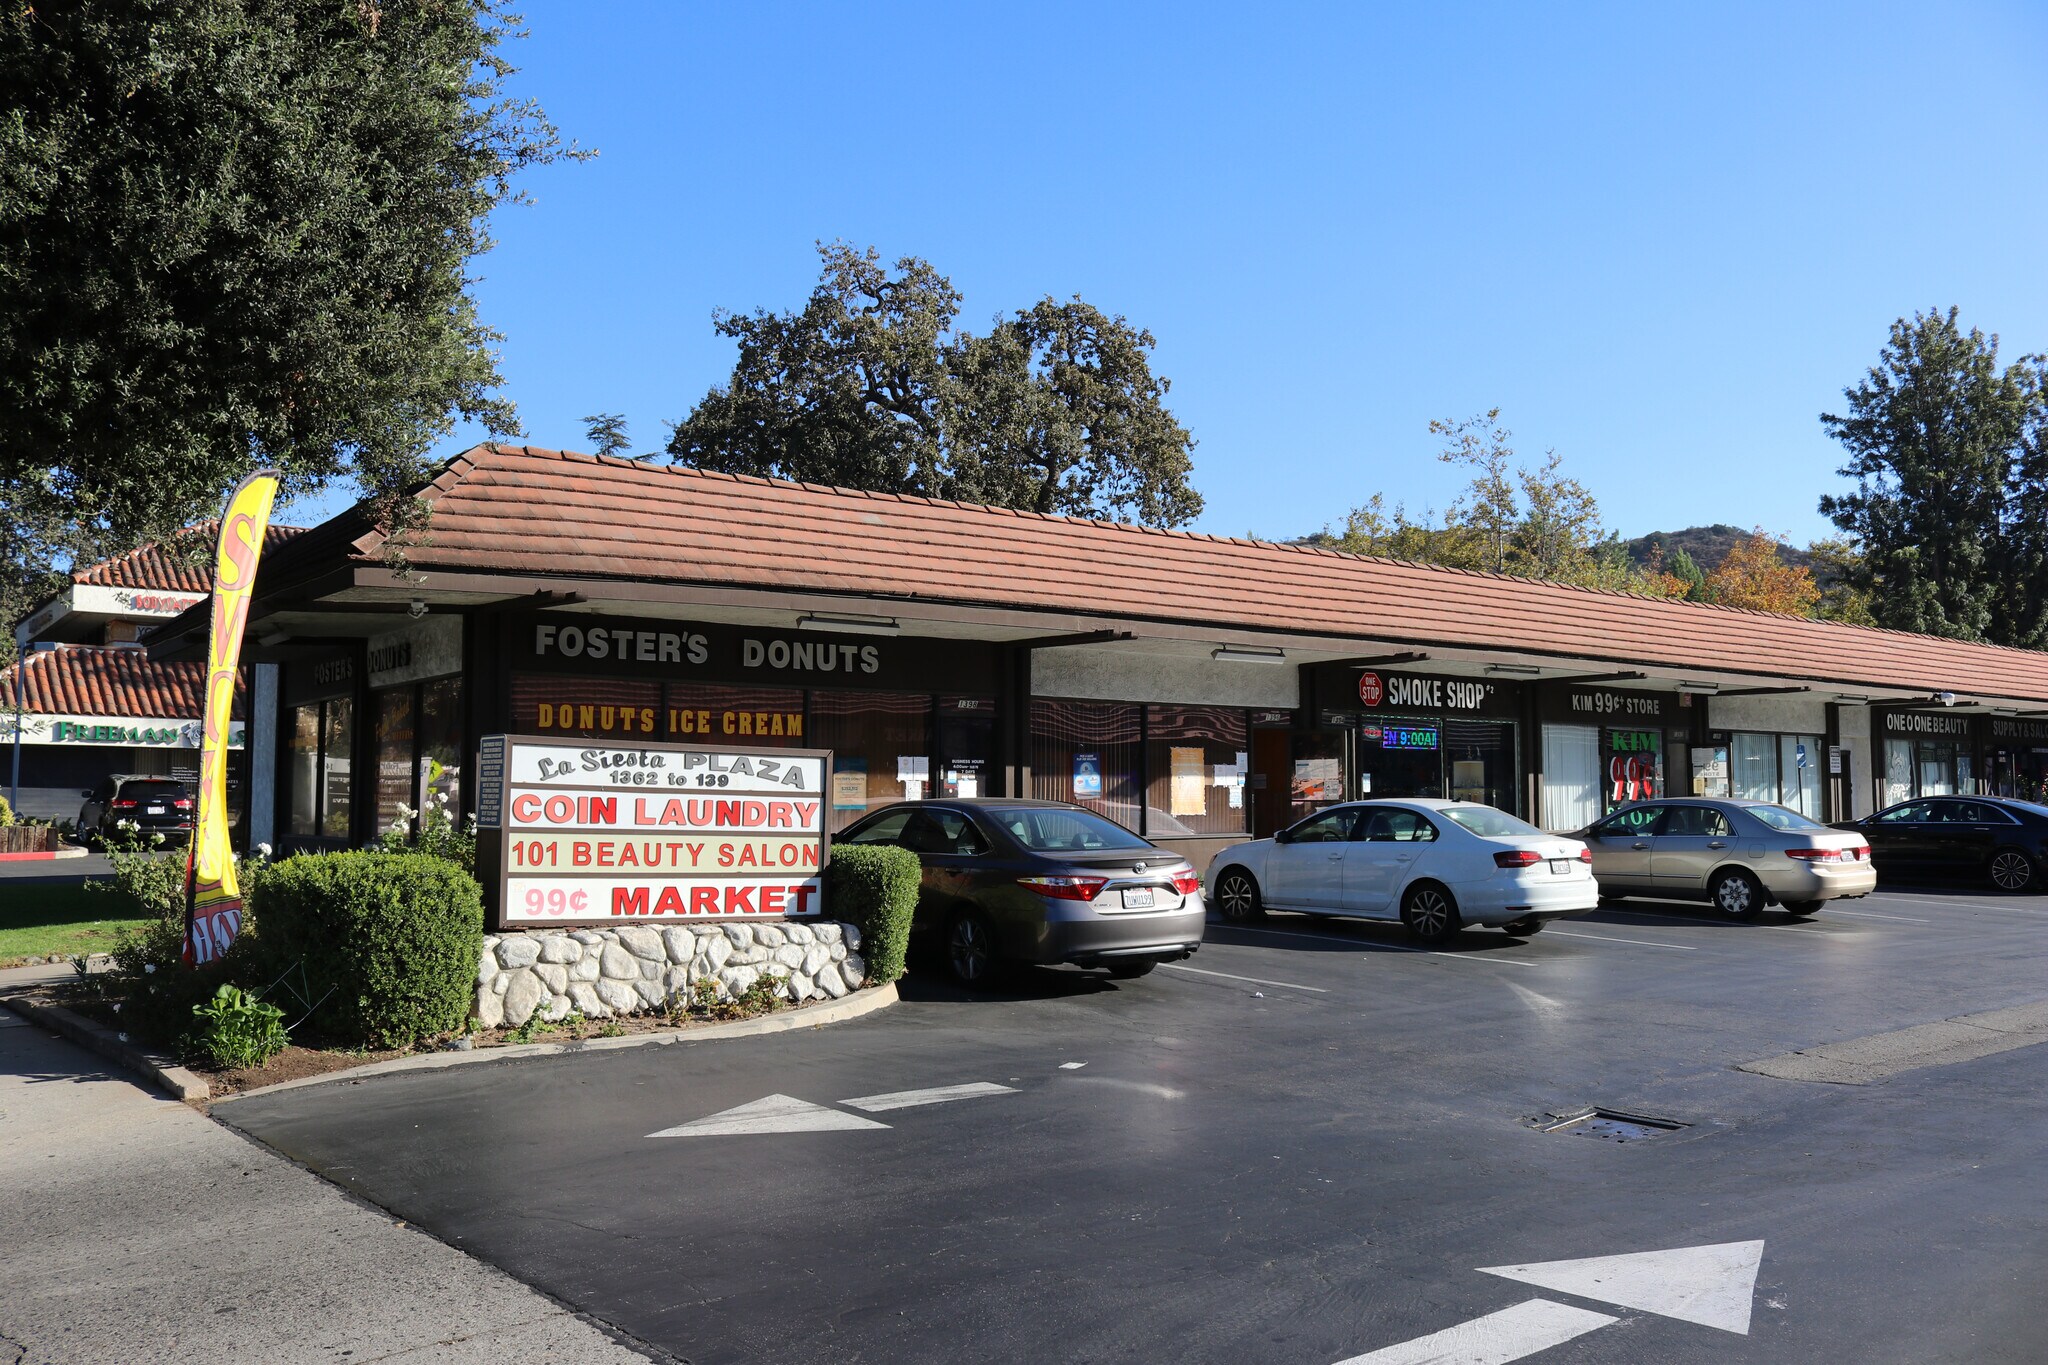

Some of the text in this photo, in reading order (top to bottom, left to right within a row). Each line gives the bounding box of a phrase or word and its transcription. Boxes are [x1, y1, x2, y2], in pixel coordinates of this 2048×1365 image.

[535, 625, 879, 674] FOSTER'S DONUTS
[1365, 676, 1376, 685] ONE
[1362, 686, 1380, 700] STOP
[1388, 677, 1442, 707] SMOKE
[1447, 681, 1485, 709] SHOP
[958, 699, 979, 709] 1398
[1572, 694, 1593, 711] KIM
[1626, 698, 1660, 715] STORE
[538, 703, 803, 737] DONUTS ICE CREAM
[1914, 715, 1933, 733] ONE
[1933, 717, 1968, 735] BEAUTY
[1992, 720, 2023, 738] SUPPLY
[2023, 722, 2029, 737] &
[58, 721, 179, 742] FREEMAN
[1612, 731, 1657, 751] KIM
[538, 749, 805, 790] La Siesta PLAZA
[609, 771, 730, 788] 1362 to 139
[512, 794, 819, 828] COIN LAUNDRY
[512, 841, 819, 867] 101 BEAUTY SALON
[525, 885, 817, 917] 99¢ MARKET
